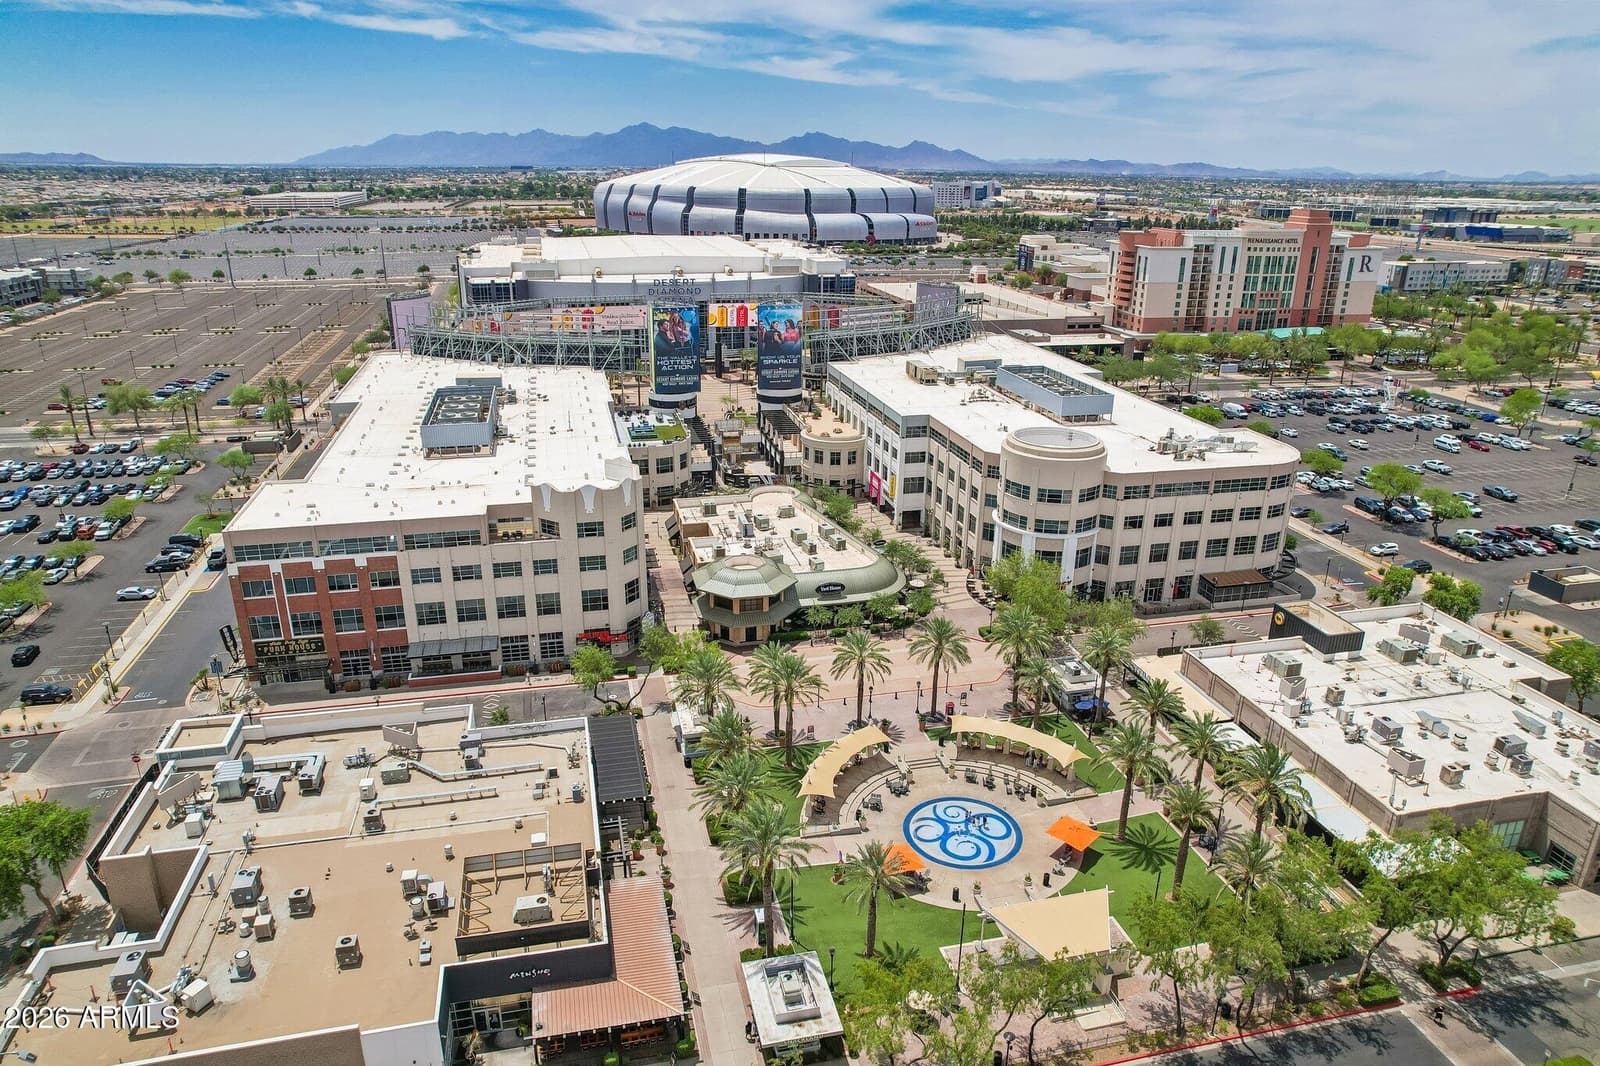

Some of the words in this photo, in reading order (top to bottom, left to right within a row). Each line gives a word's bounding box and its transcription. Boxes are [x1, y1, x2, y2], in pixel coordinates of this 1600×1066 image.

[1359, 255, 1373, 272] R
[653, 278, 696, 287] DESERT
[648, 287, 702, 296] DIAMOND
[96, 789, 118, 800] STOP
